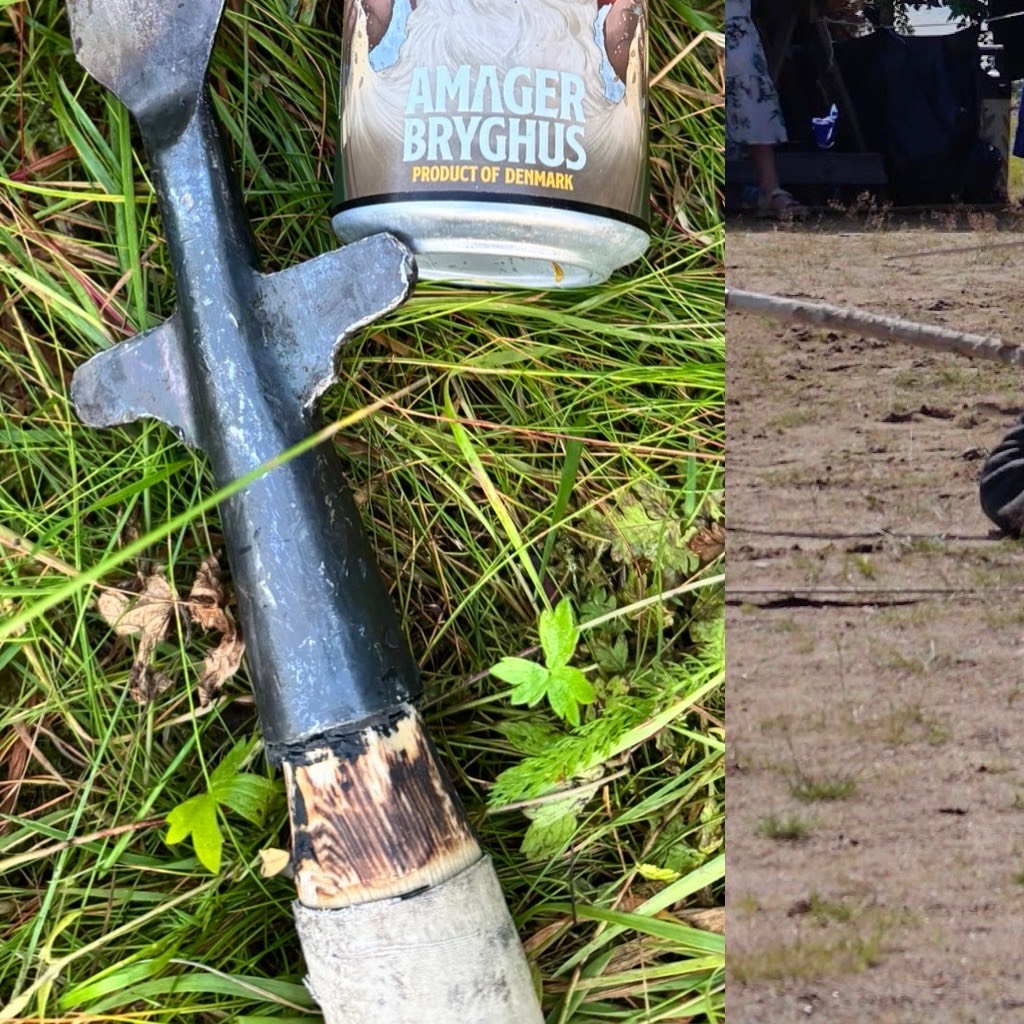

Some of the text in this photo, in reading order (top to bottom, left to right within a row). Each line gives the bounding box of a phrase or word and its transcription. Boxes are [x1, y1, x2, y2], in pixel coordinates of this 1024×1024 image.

[404, 65, 587, 123] AMAGER
[402, 116, 588, 171] BRYGHUS
[412, 166, 574, 191] PRODUCT OF DENMARK
